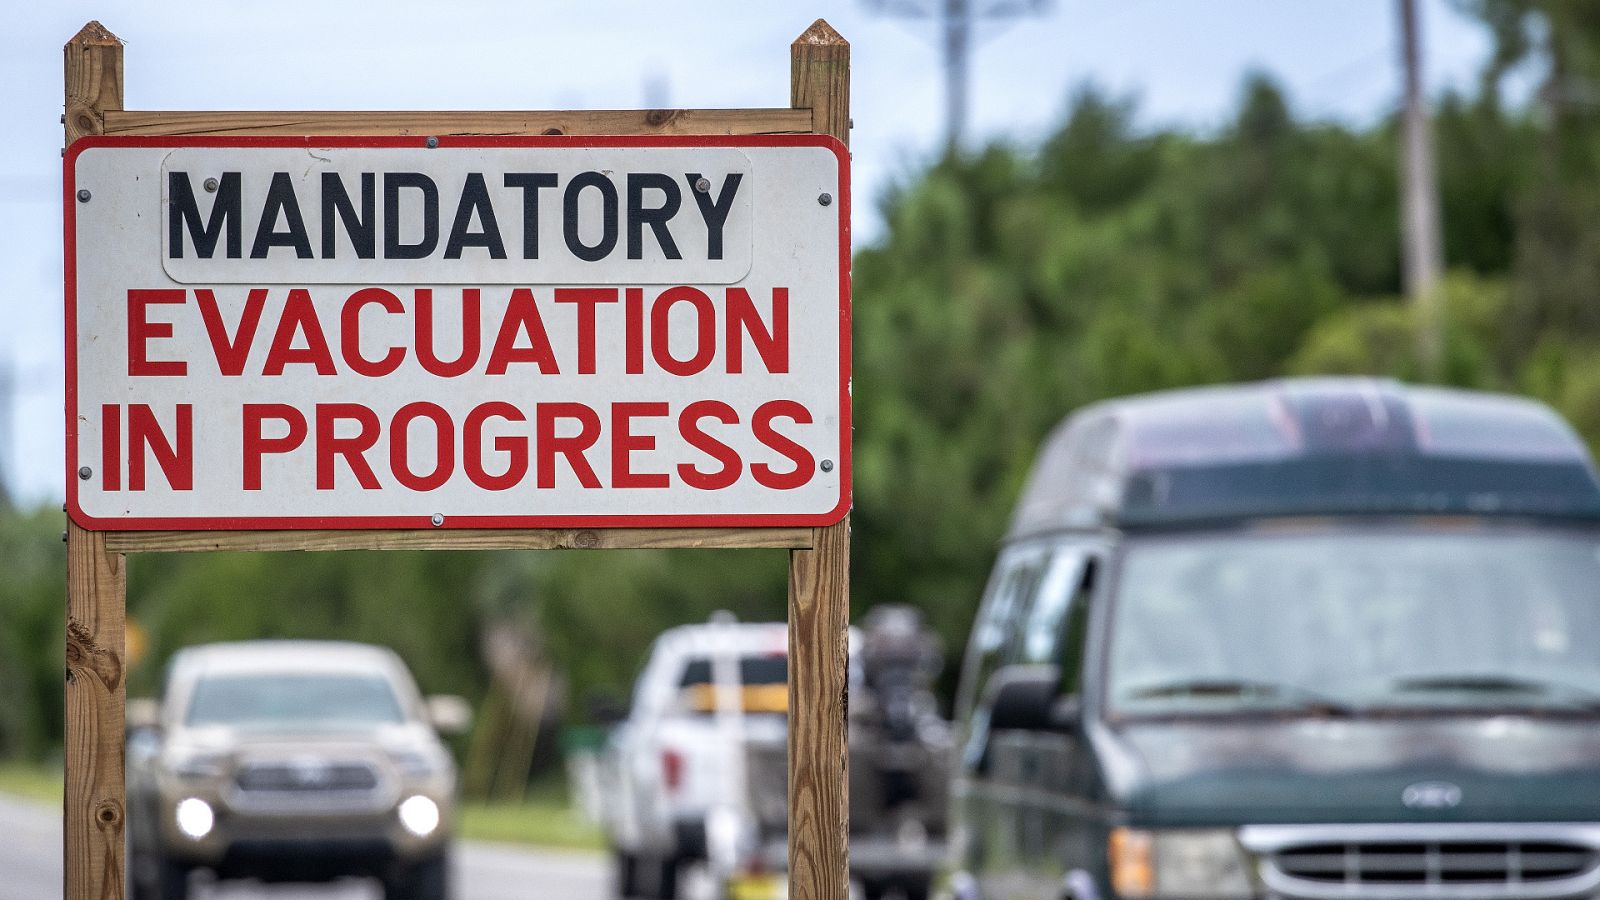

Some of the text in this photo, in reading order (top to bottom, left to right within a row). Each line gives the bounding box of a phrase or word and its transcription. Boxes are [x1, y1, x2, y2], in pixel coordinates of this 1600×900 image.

[168, 171, 744, 261] MANDATORY
[127, 287, 790, 377] EVACUATION
[101, 400, 816, 491] IN PROGRESS
